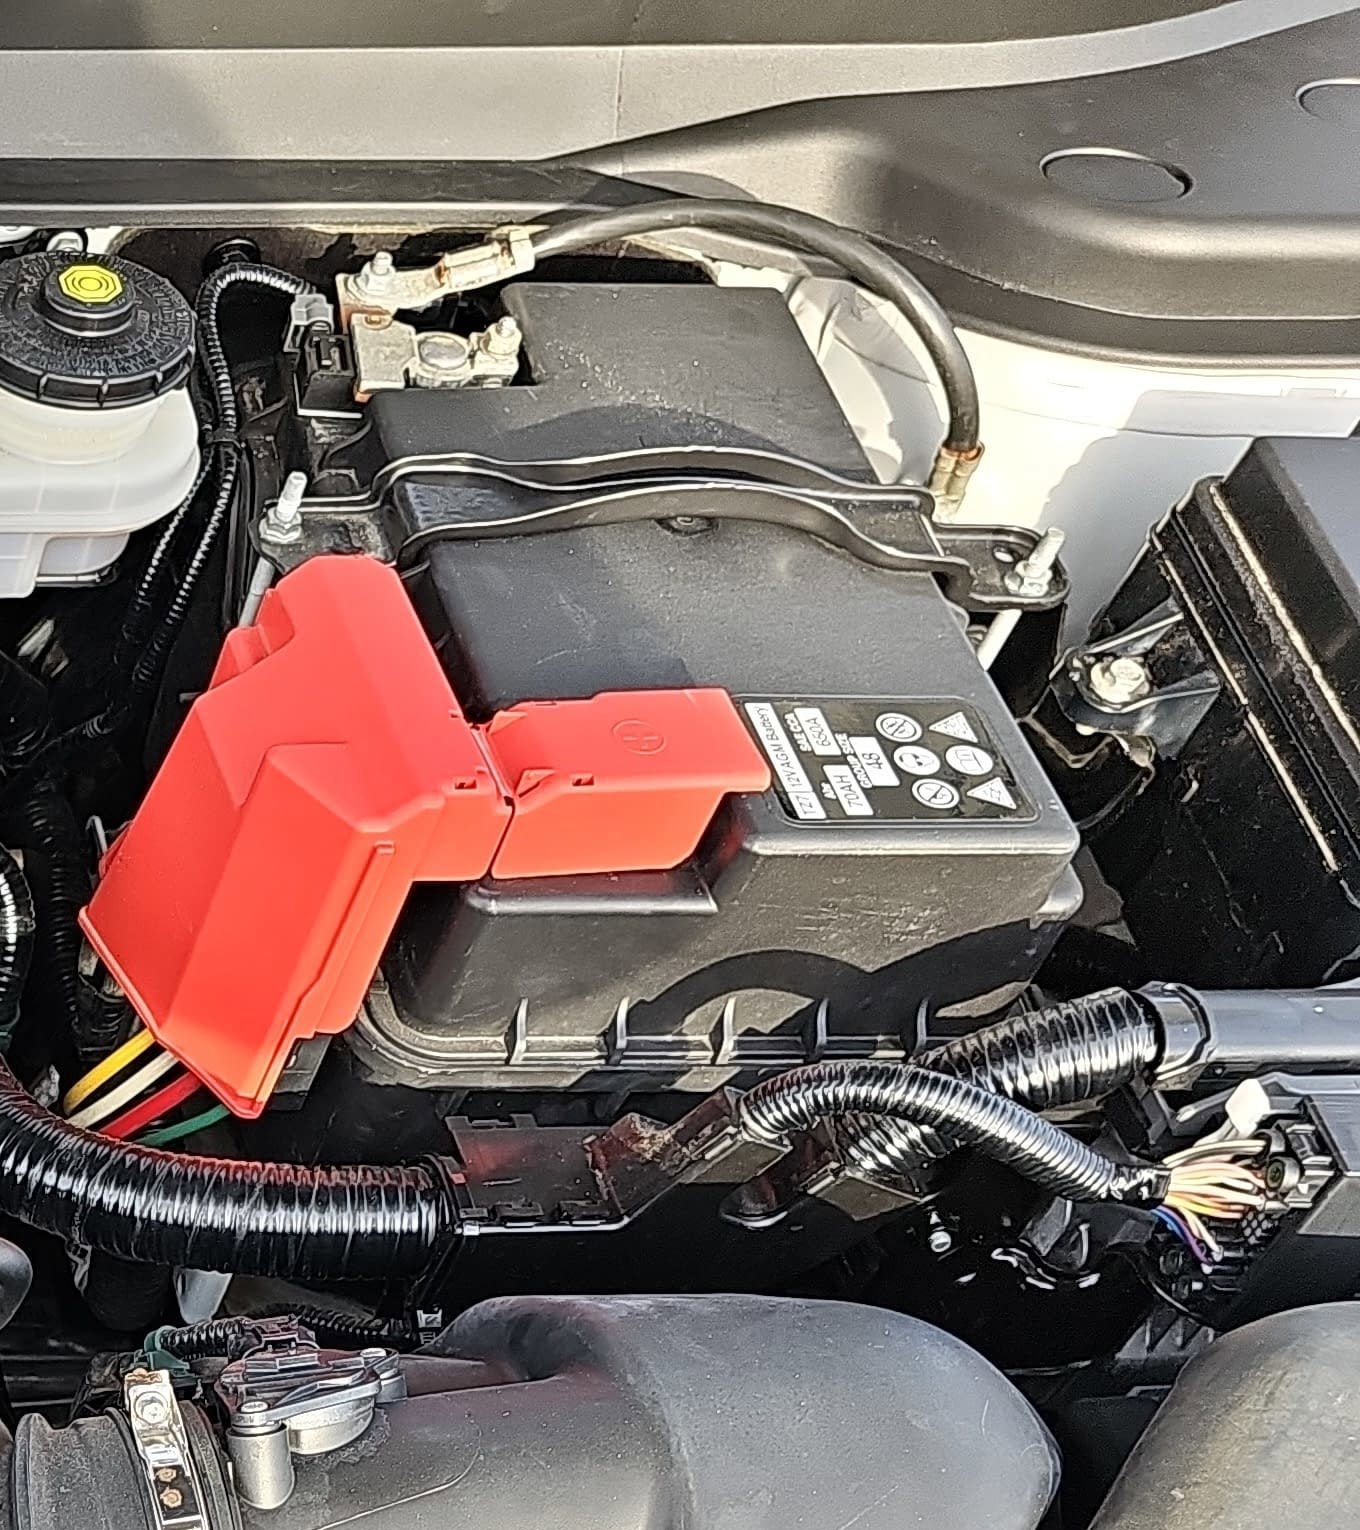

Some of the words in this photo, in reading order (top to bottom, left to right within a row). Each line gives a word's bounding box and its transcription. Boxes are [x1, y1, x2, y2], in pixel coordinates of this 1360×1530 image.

[752, 705, 780, 741] Battery
[783, 712, 803, 733] CCA
[804, 717, 832, 747] 650A
[792, 732, 813, 752] SAE
[834, 732, 855, 755] SIZE
[846, 754, 873, 789] GROUP
[861, 752, 884, 770] 48
[832, 774, 864, 808] 70AH
